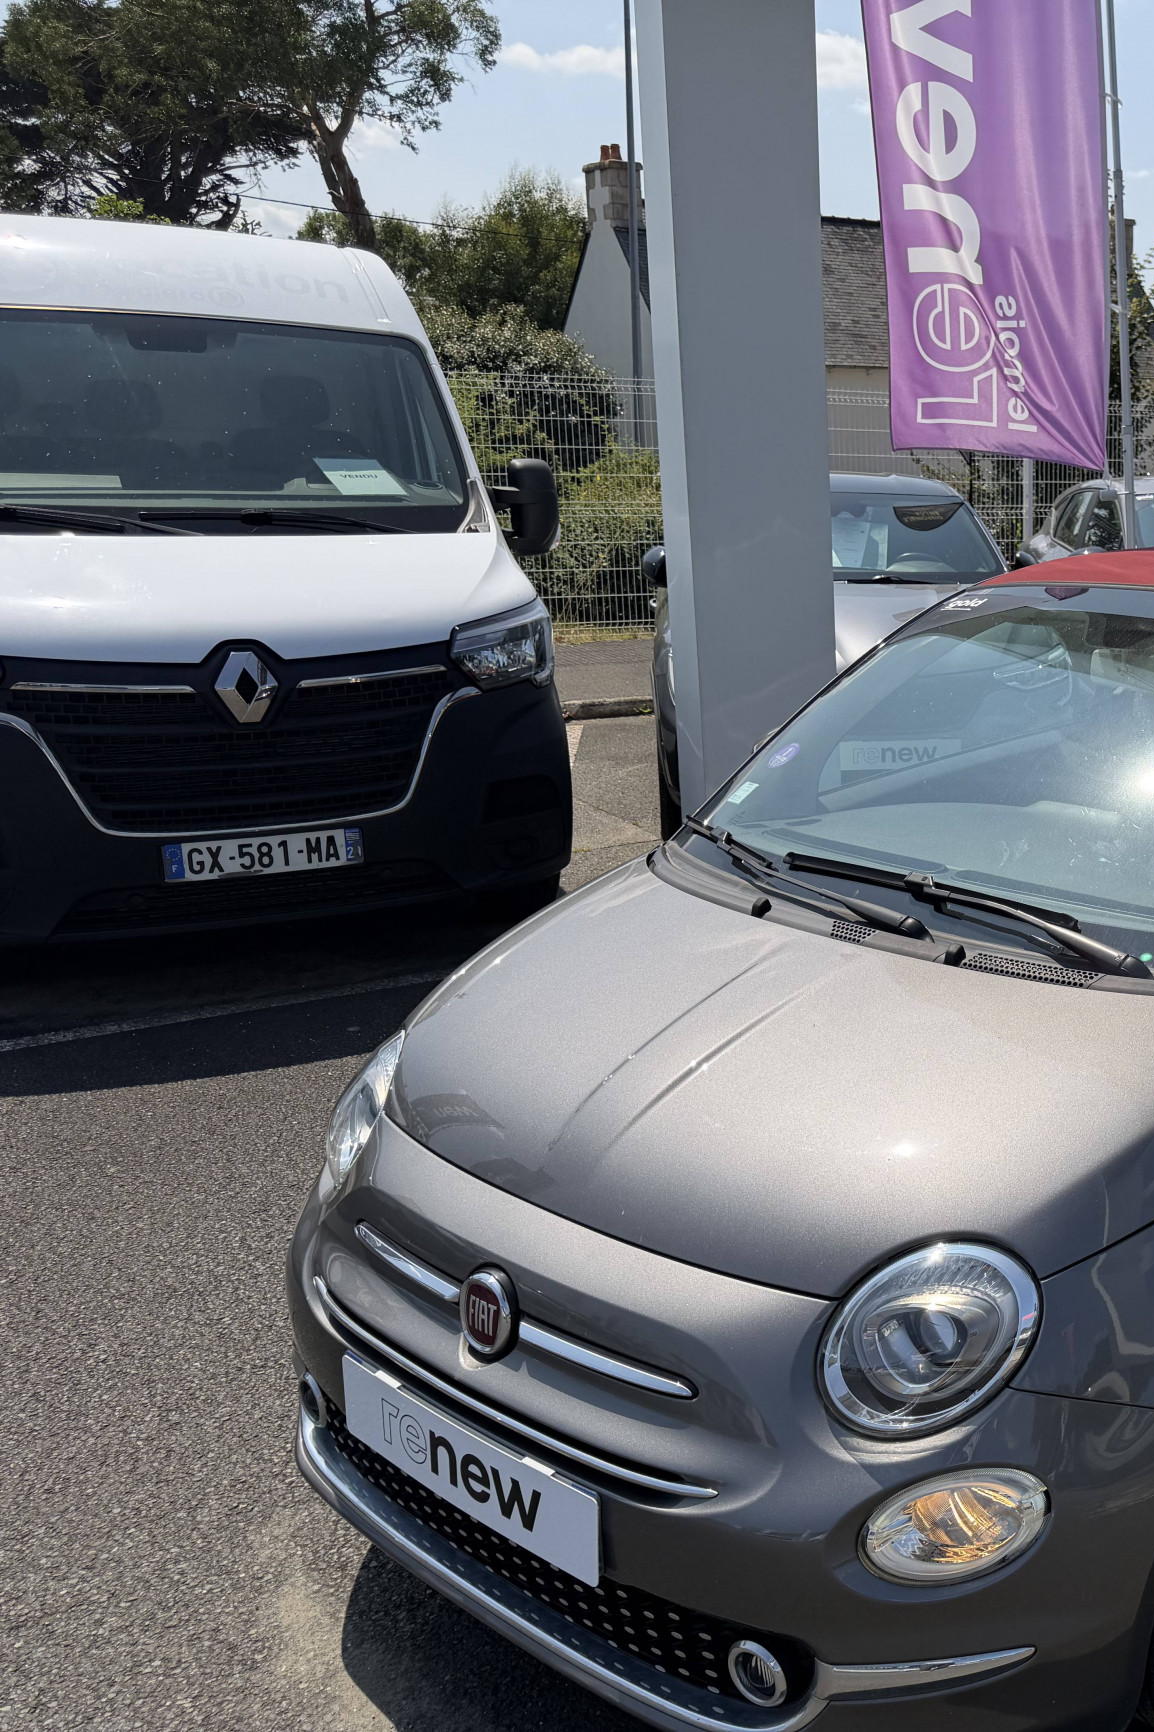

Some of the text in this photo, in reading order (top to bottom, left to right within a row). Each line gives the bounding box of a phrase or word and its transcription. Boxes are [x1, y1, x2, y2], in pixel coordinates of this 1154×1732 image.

[852, 745, 938, 765] renew
[172, 864, 178, 873] F
[187, 835, 341, 875] GX-581-MA
[469, 1294, 498, 1337] FIAT
[381, 1397, 542, 1533] renew
